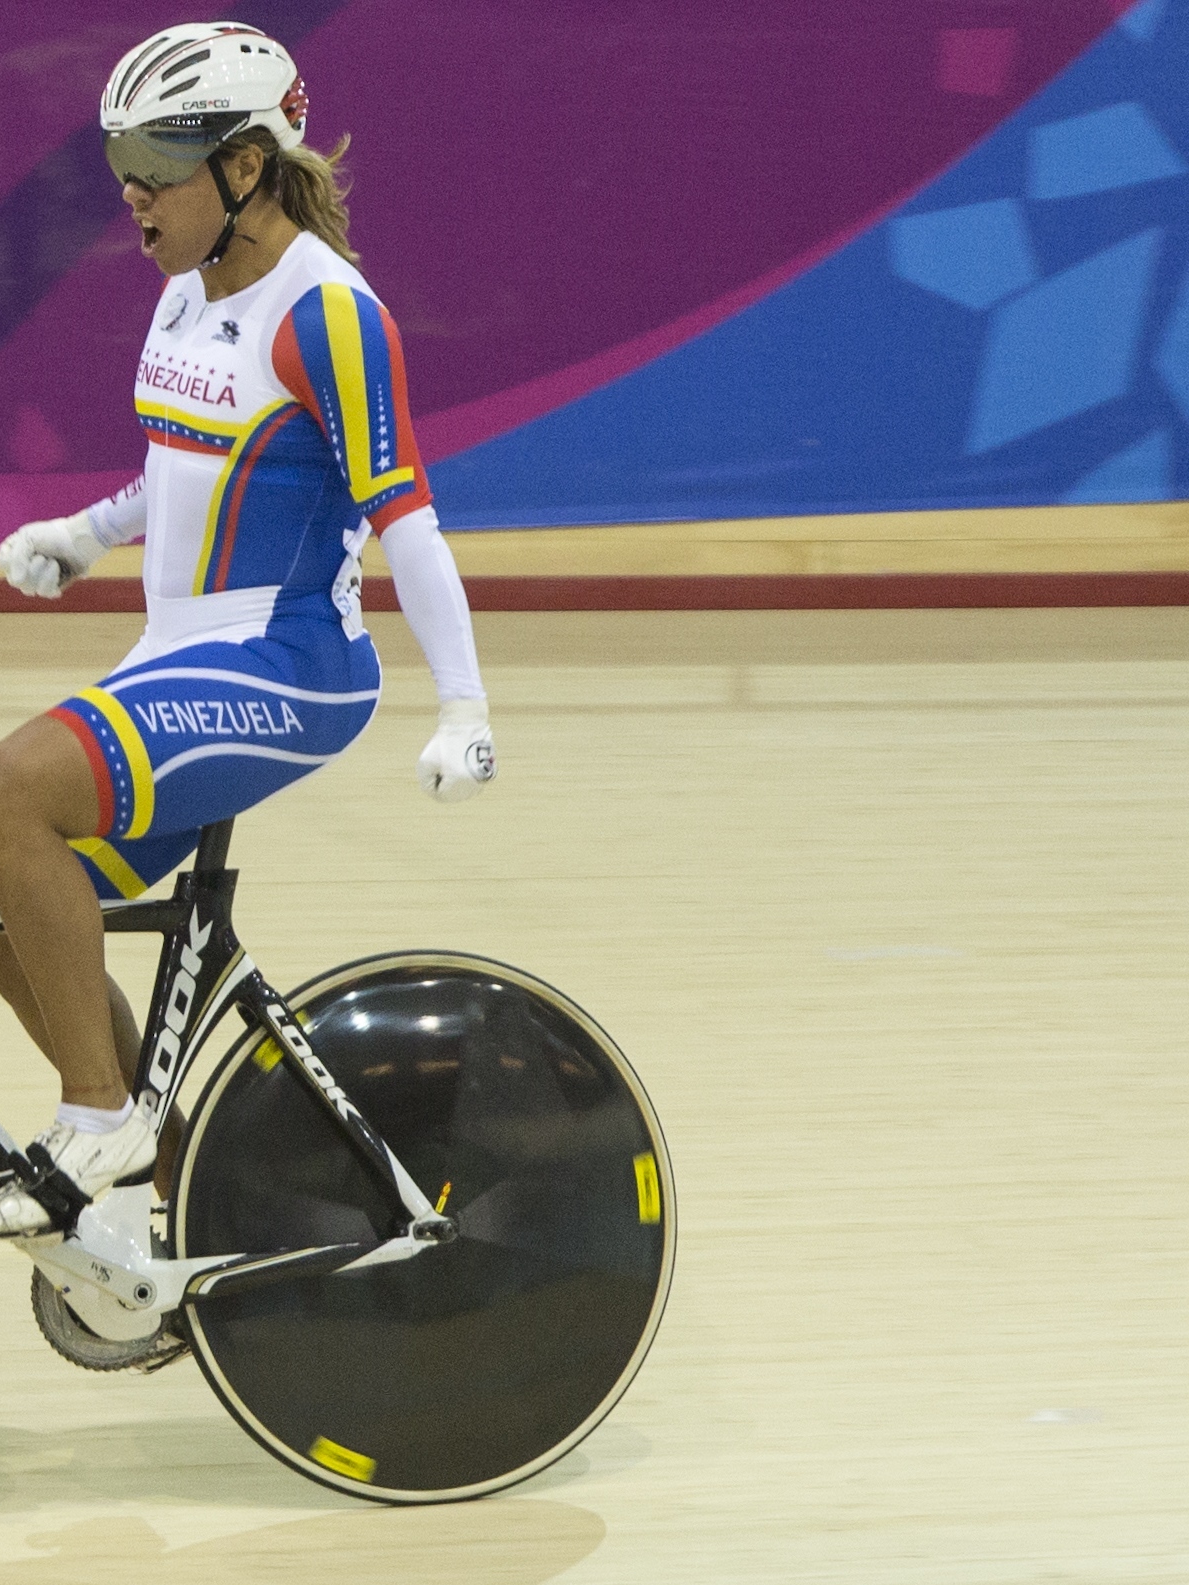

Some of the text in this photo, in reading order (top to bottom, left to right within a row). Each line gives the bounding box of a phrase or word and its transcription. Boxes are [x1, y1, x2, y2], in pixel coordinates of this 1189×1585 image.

[137, 360, 236, 408] ENEZUELA
[135, 701, 304, 735] VENEZUELA
[266, 1003, 363, 1121] LOOK
